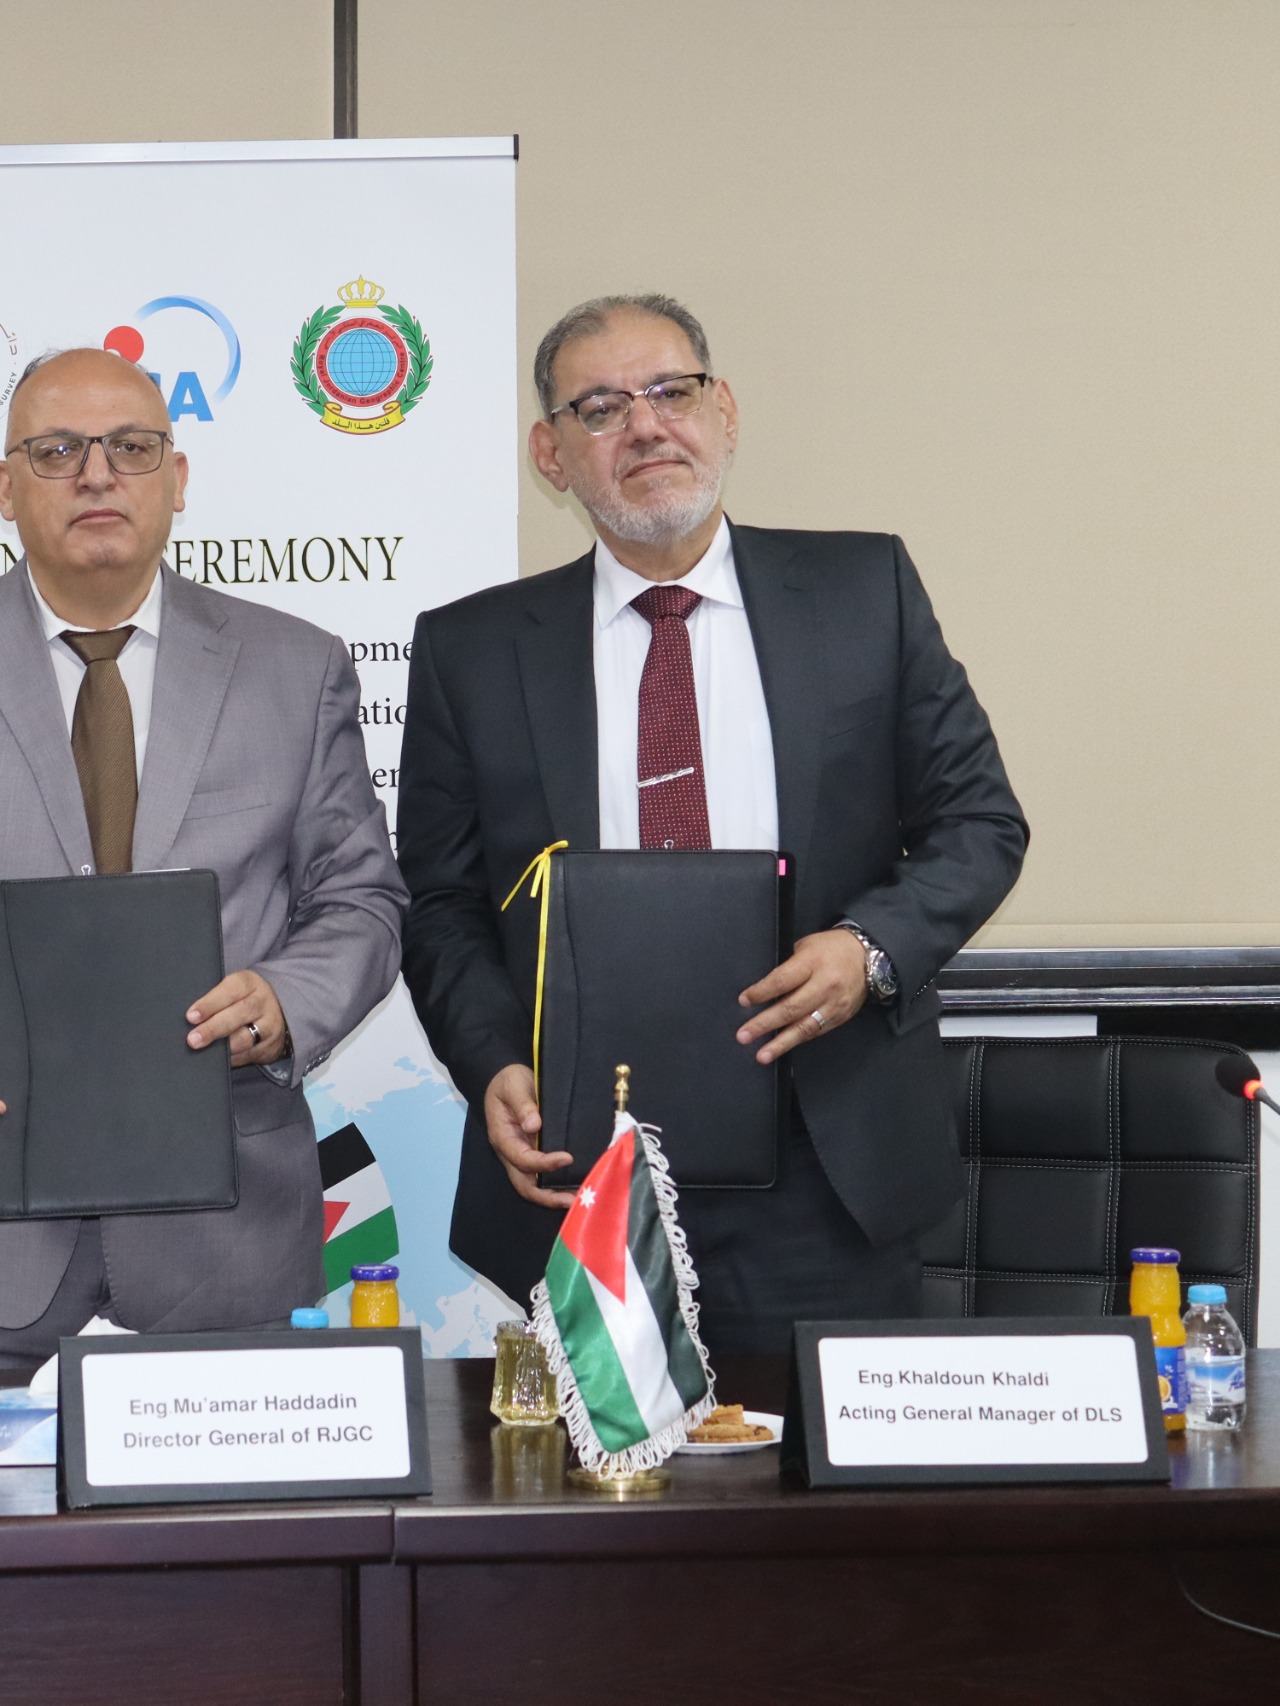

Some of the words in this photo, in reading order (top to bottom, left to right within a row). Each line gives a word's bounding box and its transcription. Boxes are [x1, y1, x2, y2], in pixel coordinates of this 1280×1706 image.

[317, 354, 327, 376] Royal
[323, 378, 357, 404] Jordanian
[360, 380, 400, 404] Geographic
[164, 537, 404, 584] EREMONY
[992, 1371, 1050, 1387] Khaldi
[264, 1393, 358, 1412] Haddadin
[839, 1405, 896, 1424] Acting
[903, 1405, 972, 1421] General
[979, 1407, 1055, 1424] Manager
[1062, 1407, 1078, 1421] of
[1085, 1407, 1123, 1422] DLS
[123, 1432, 202, 1449] Director
[209, 1428, 285, 1446] General
[291, 1427, 310, 1444] of
[317, 1425, 373, 1443] RJGC
